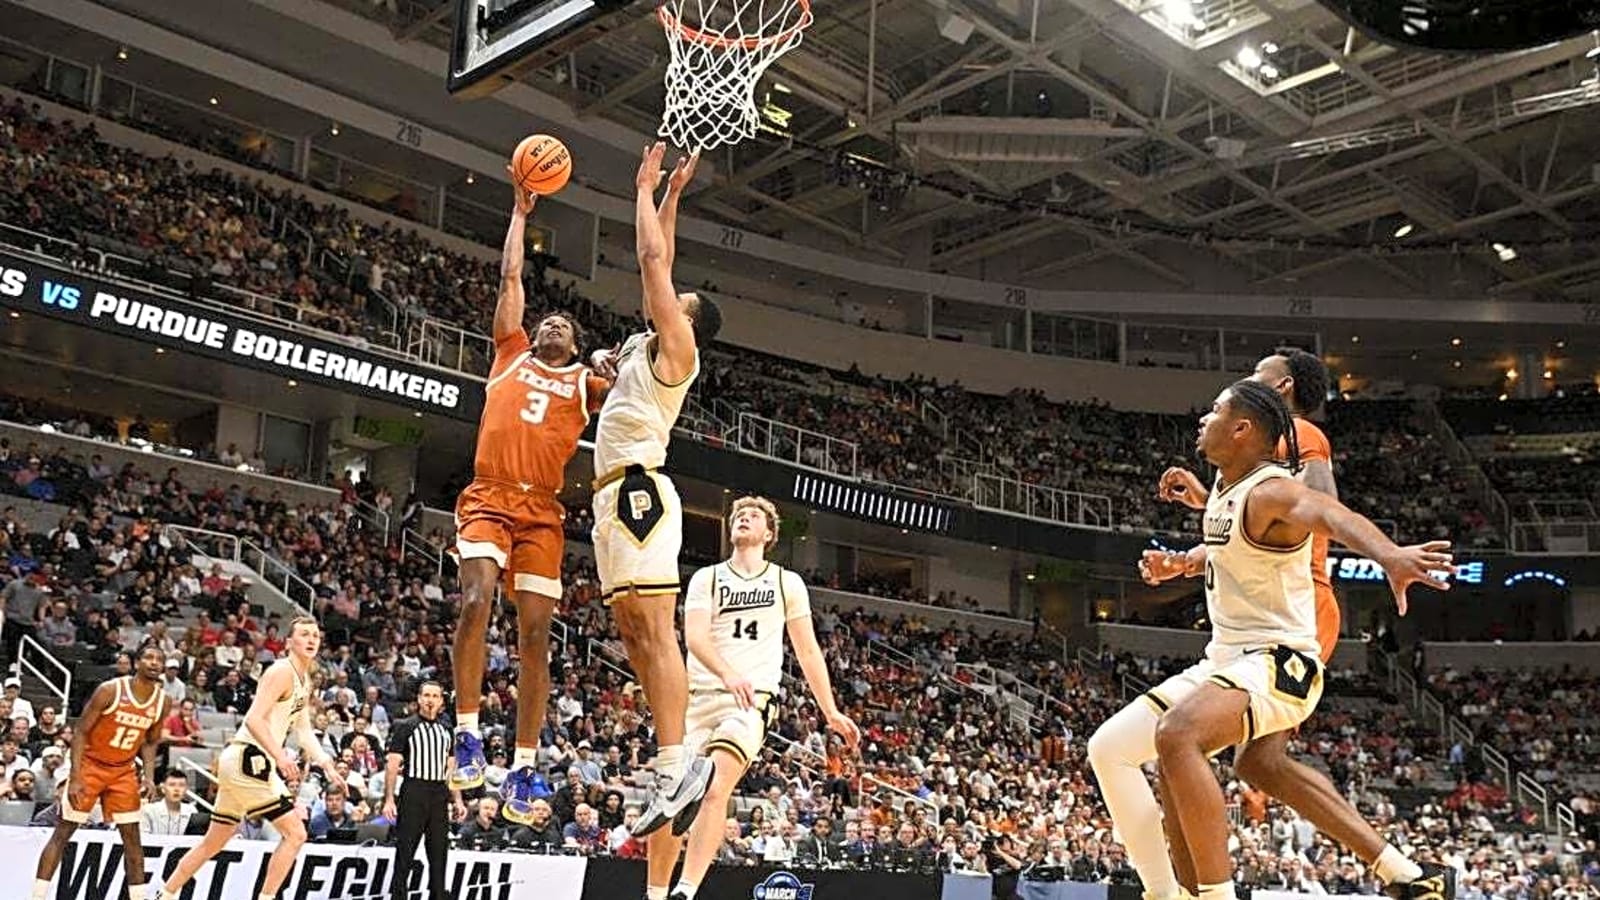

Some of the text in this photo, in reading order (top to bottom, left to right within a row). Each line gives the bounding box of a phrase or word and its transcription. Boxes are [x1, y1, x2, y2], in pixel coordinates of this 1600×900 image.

[396, 120, 422, 147] 216
[538, 147, 568, 173] Wilson
[720, 227, 744, 249] 217
[0, 266, 460, 408] S VS PURDUE BOILERMAKERS
[516, 366, 577, 400] TEXAS
[520, 391, 551, 424] 3
[719, 585, 775, 612] Purdue
[732, 618, 758, 640] 14
[109, 726, 140, 750] 12
